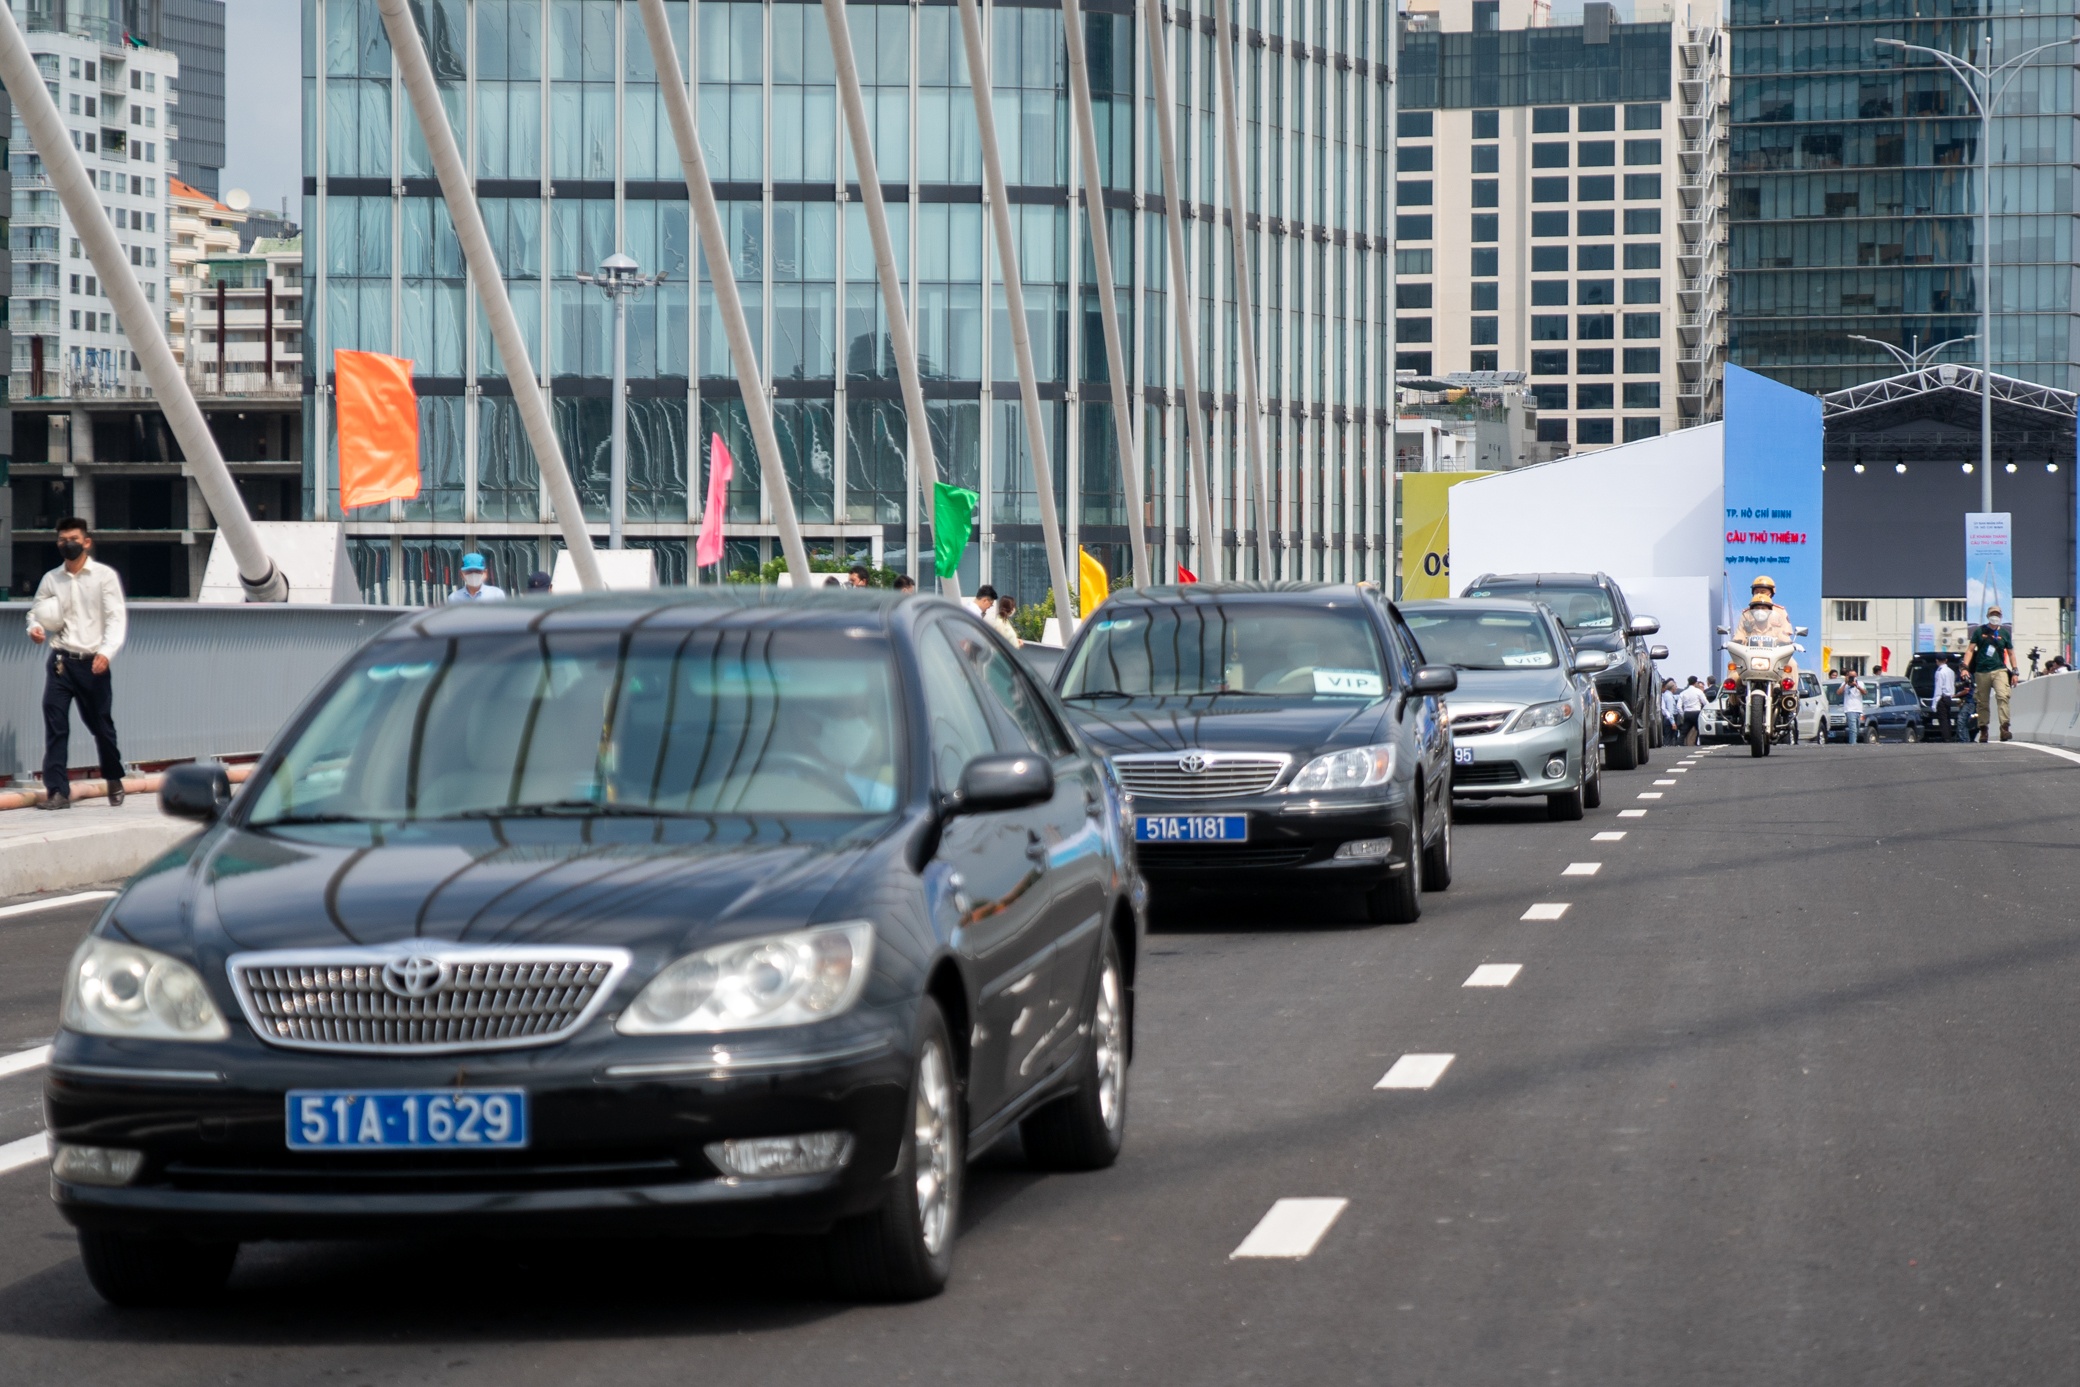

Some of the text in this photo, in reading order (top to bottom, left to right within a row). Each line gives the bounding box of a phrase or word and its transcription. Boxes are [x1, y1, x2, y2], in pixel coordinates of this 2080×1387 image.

[1726, 508, 1738, 518] TP.
[1755, 507, 1770, 519] CHÍ
[1771, 509, 1792, 519] MINH
[1726, 530, 1746, 543] CẦU
[1800, 533, 1807, 545] 2
[1514, 656, 1542, 664] VIP
[1328, 676, 1368, 688] VIP
[1146, 817, 1225, 839] 51A-1181
